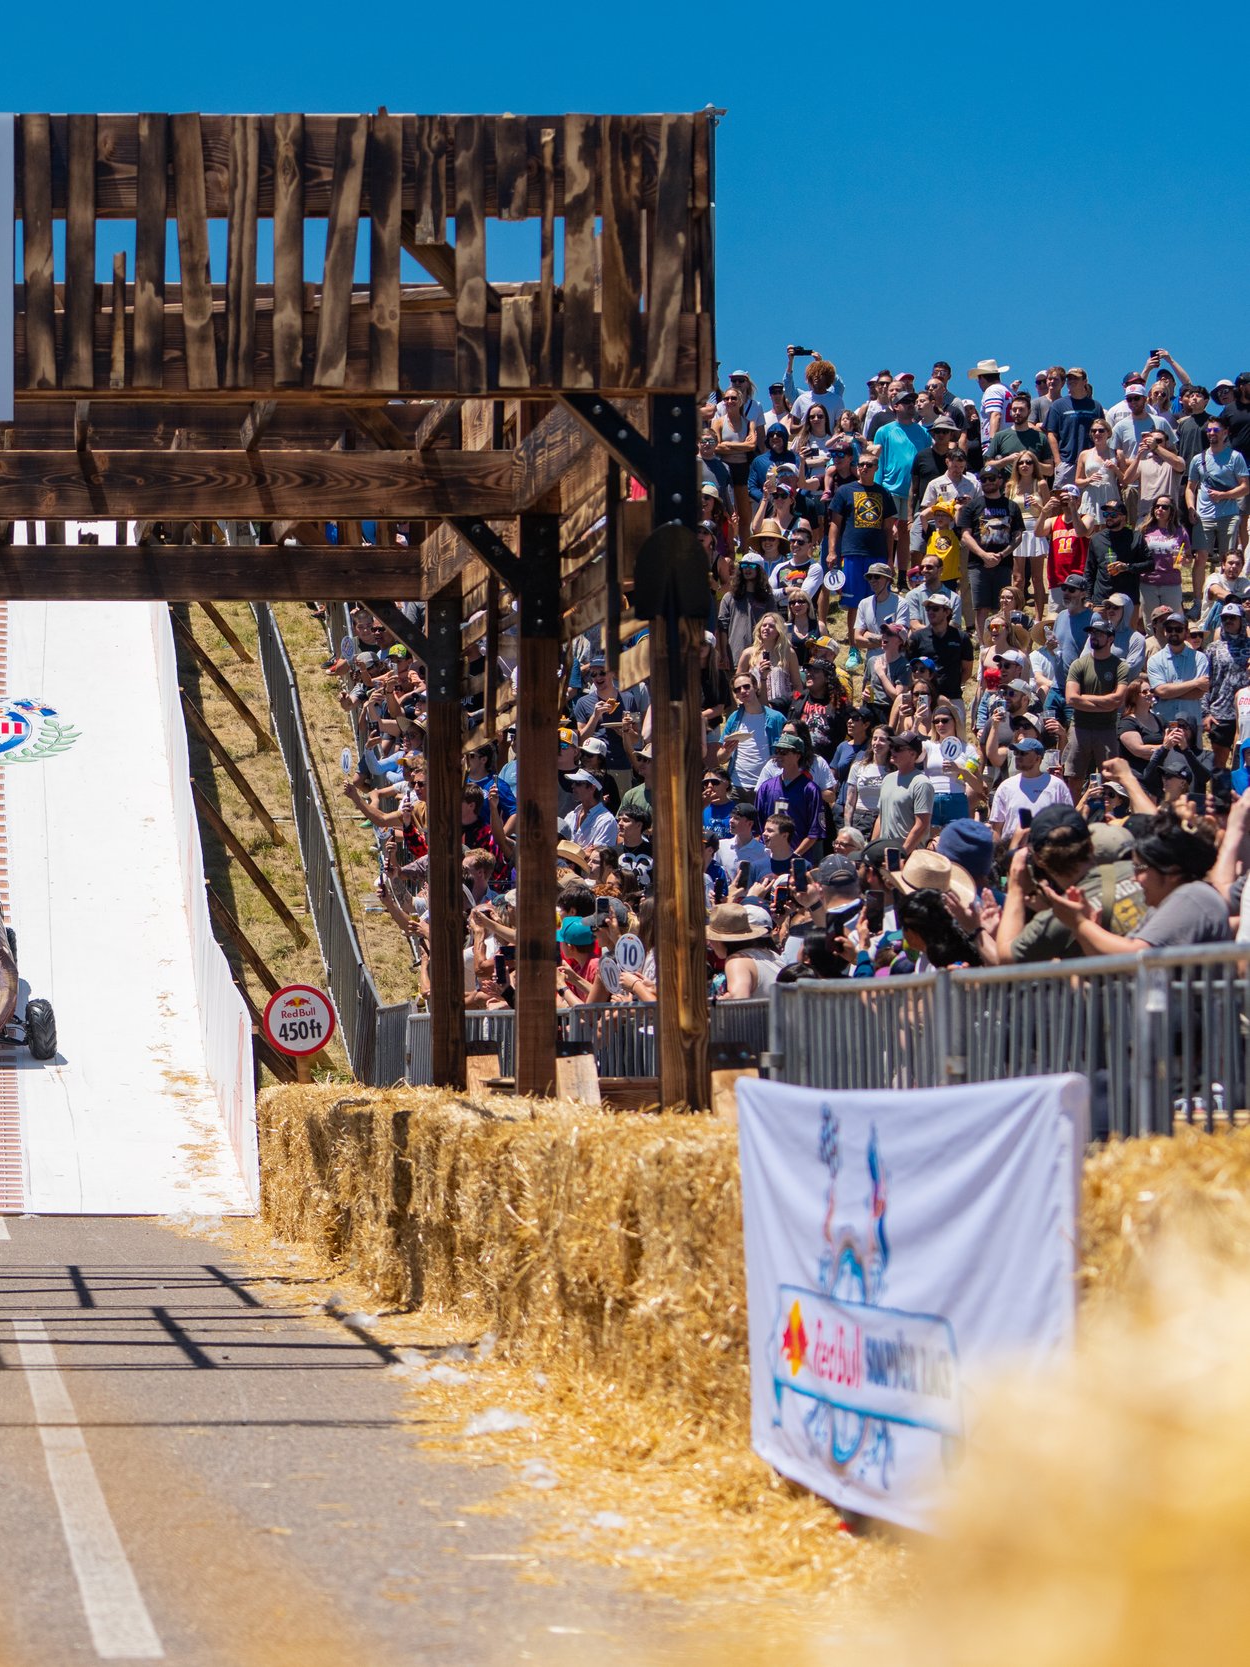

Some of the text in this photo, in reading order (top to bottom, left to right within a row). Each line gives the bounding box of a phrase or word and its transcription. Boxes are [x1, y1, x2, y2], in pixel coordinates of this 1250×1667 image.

[1058, 537, 1073, 553] 11
[944, 741, 957, 758] 10
[622, 943, 638, 967] 10
[605, 967, 617, 988] 10
[281, 1007, 316, 1019] Red Bull
